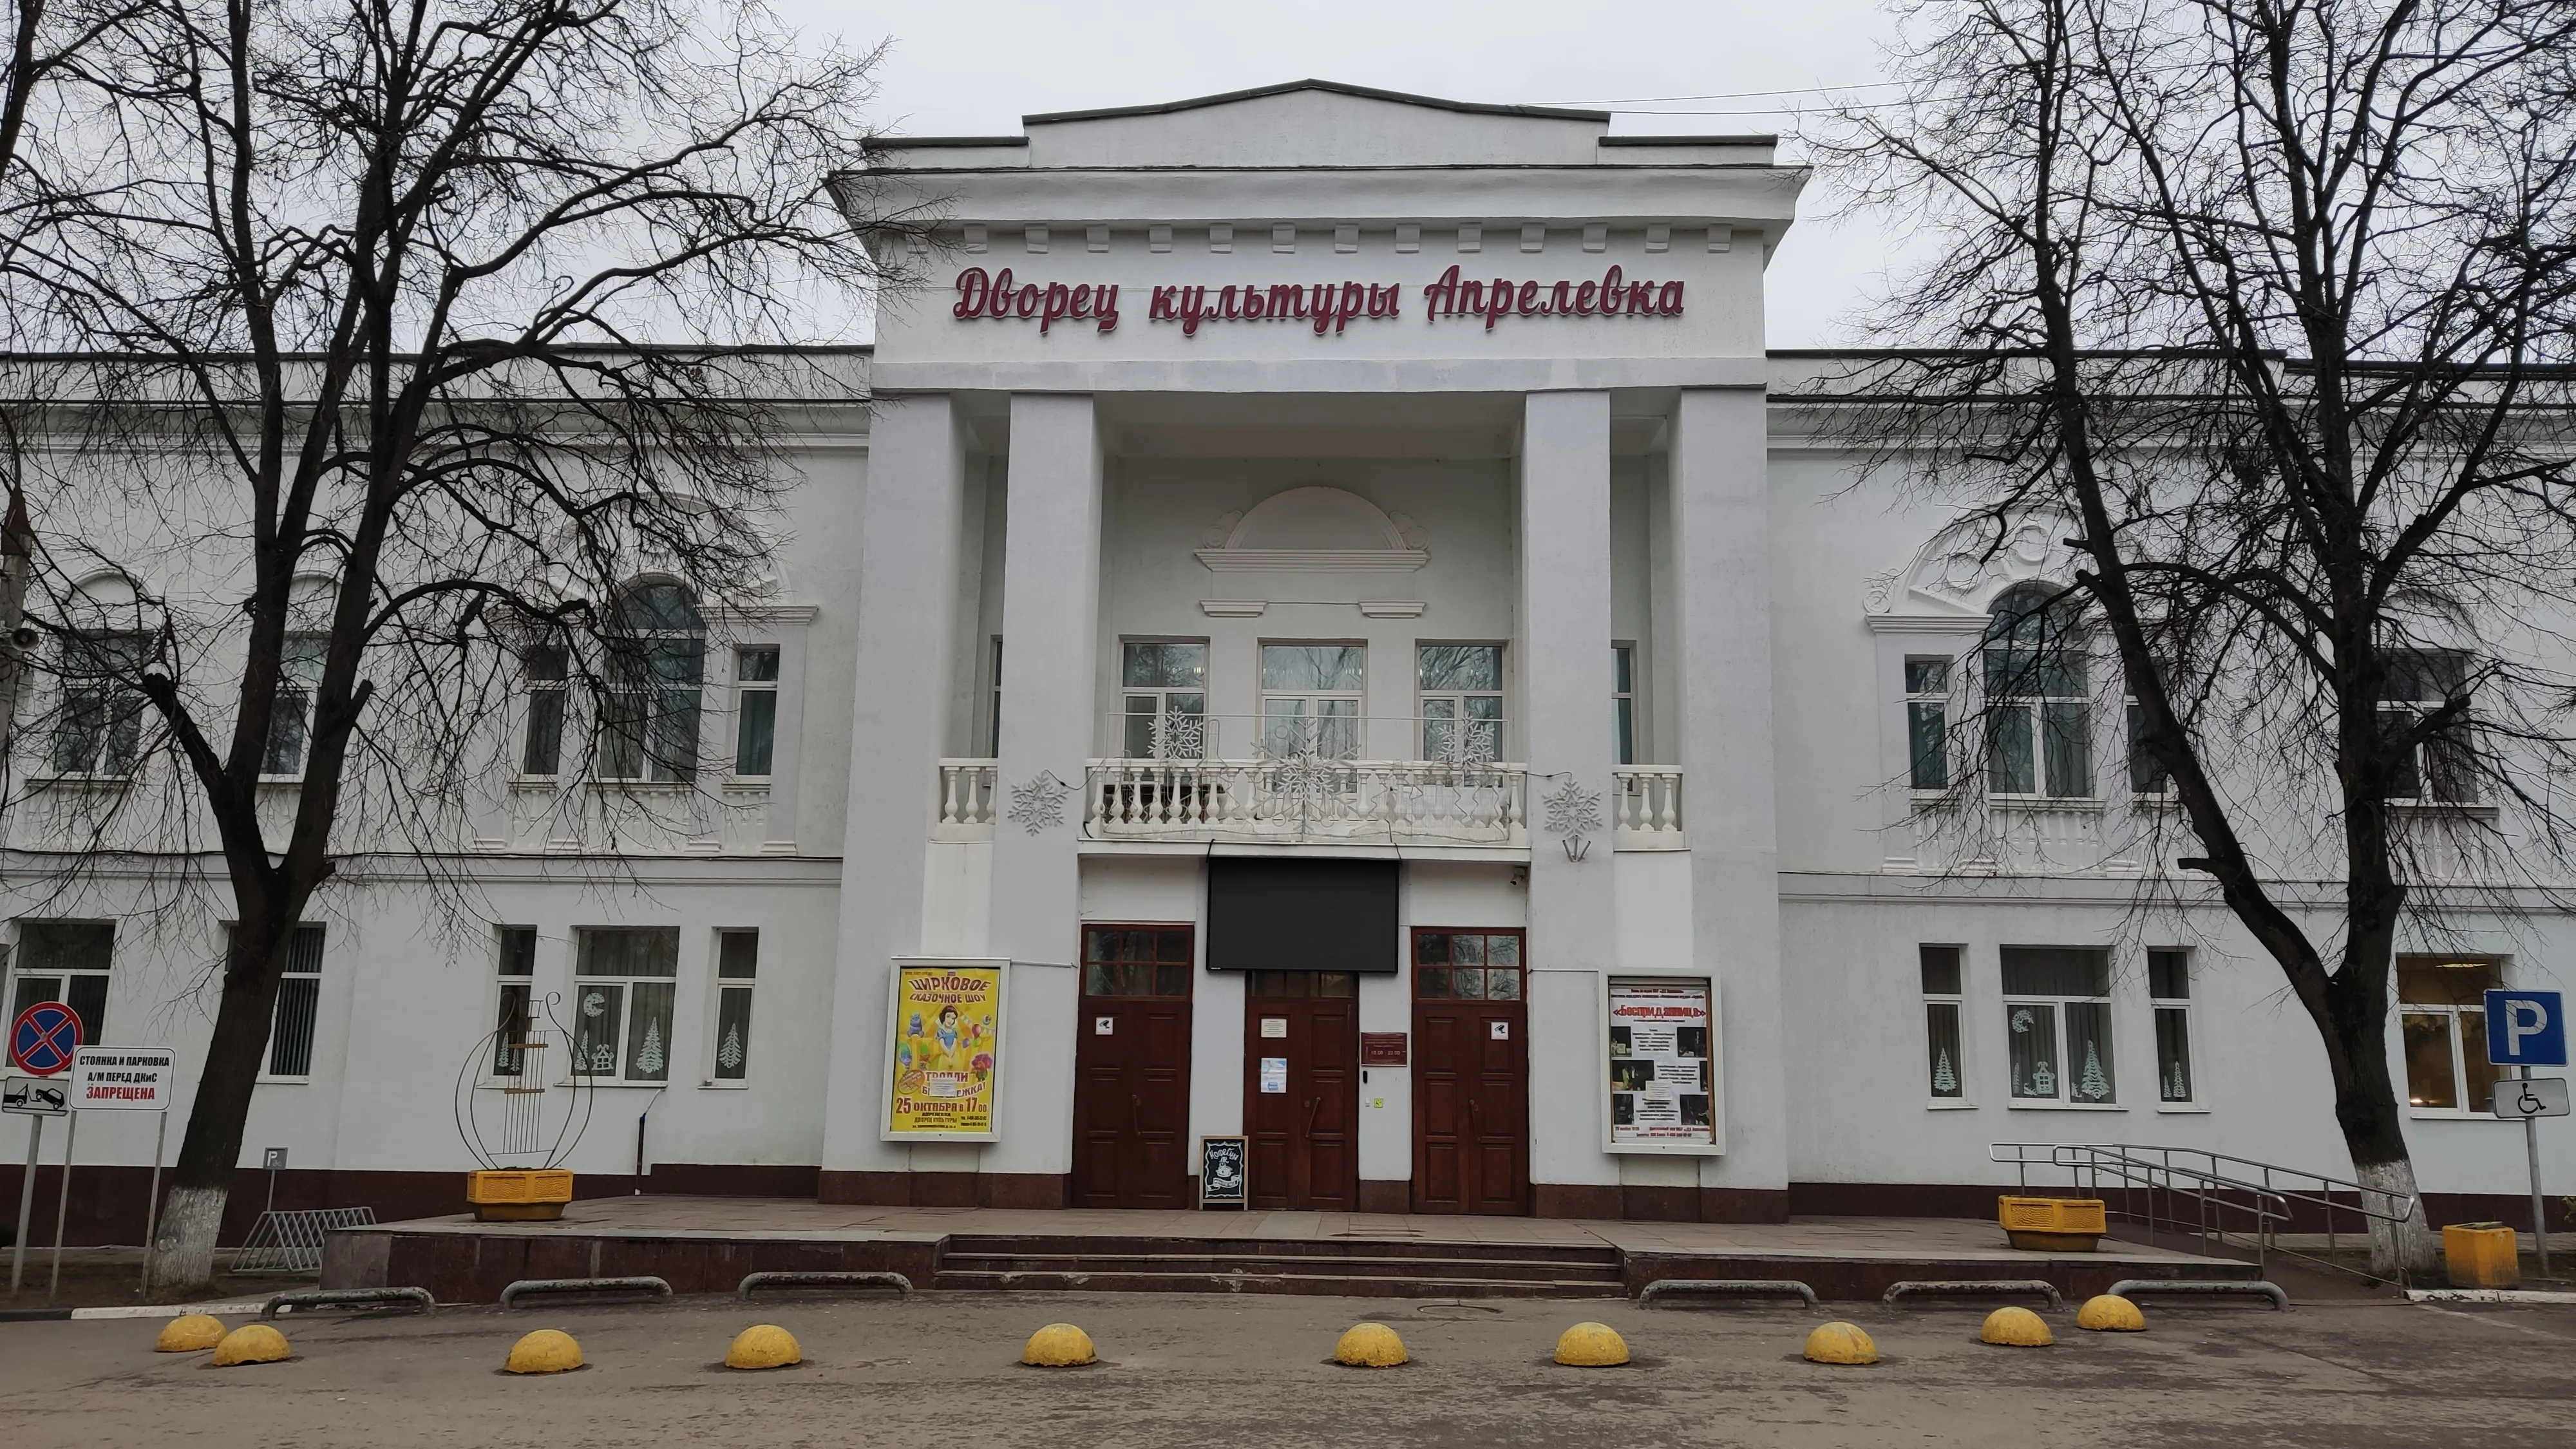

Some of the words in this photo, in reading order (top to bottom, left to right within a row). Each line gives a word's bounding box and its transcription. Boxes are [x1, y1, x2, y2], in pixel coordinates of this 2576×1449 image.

[953, 267, 1119, 336] Дворец
[1149, 281, 1400, 336] культуры
[1423, 264, 1685, 332] Апрелевка
[909, 976, 992, 991] ЦИРКОВОЕ
[909, 993, 962, 1003] СКАЗОЧНОЕ
[965, 994, 987, 1003] ШОУ
[80, 1056, 117, 1066] СТОЯНКА
[119, 1056, 124, 1066] И
[126, 1056, 169, 1066] ПАРКОВКА
[88, 1072, 104, 1082] А/М
[106, 1072, 132, 1083] ПЕРЕД
[133, 1072, 157, 1084] ДКиС
[86, 1086, 155, 1101] ЗАПРЕЩЕНА
[895, 1097, 911, 1114] 25
[914, 1102, 958, 1112] ОКТЯБРЯ
[966, 1097, 978, 1112] 17
[978, 1104, 987, 1112] 00
[267, 1151, 278, 1167] P
